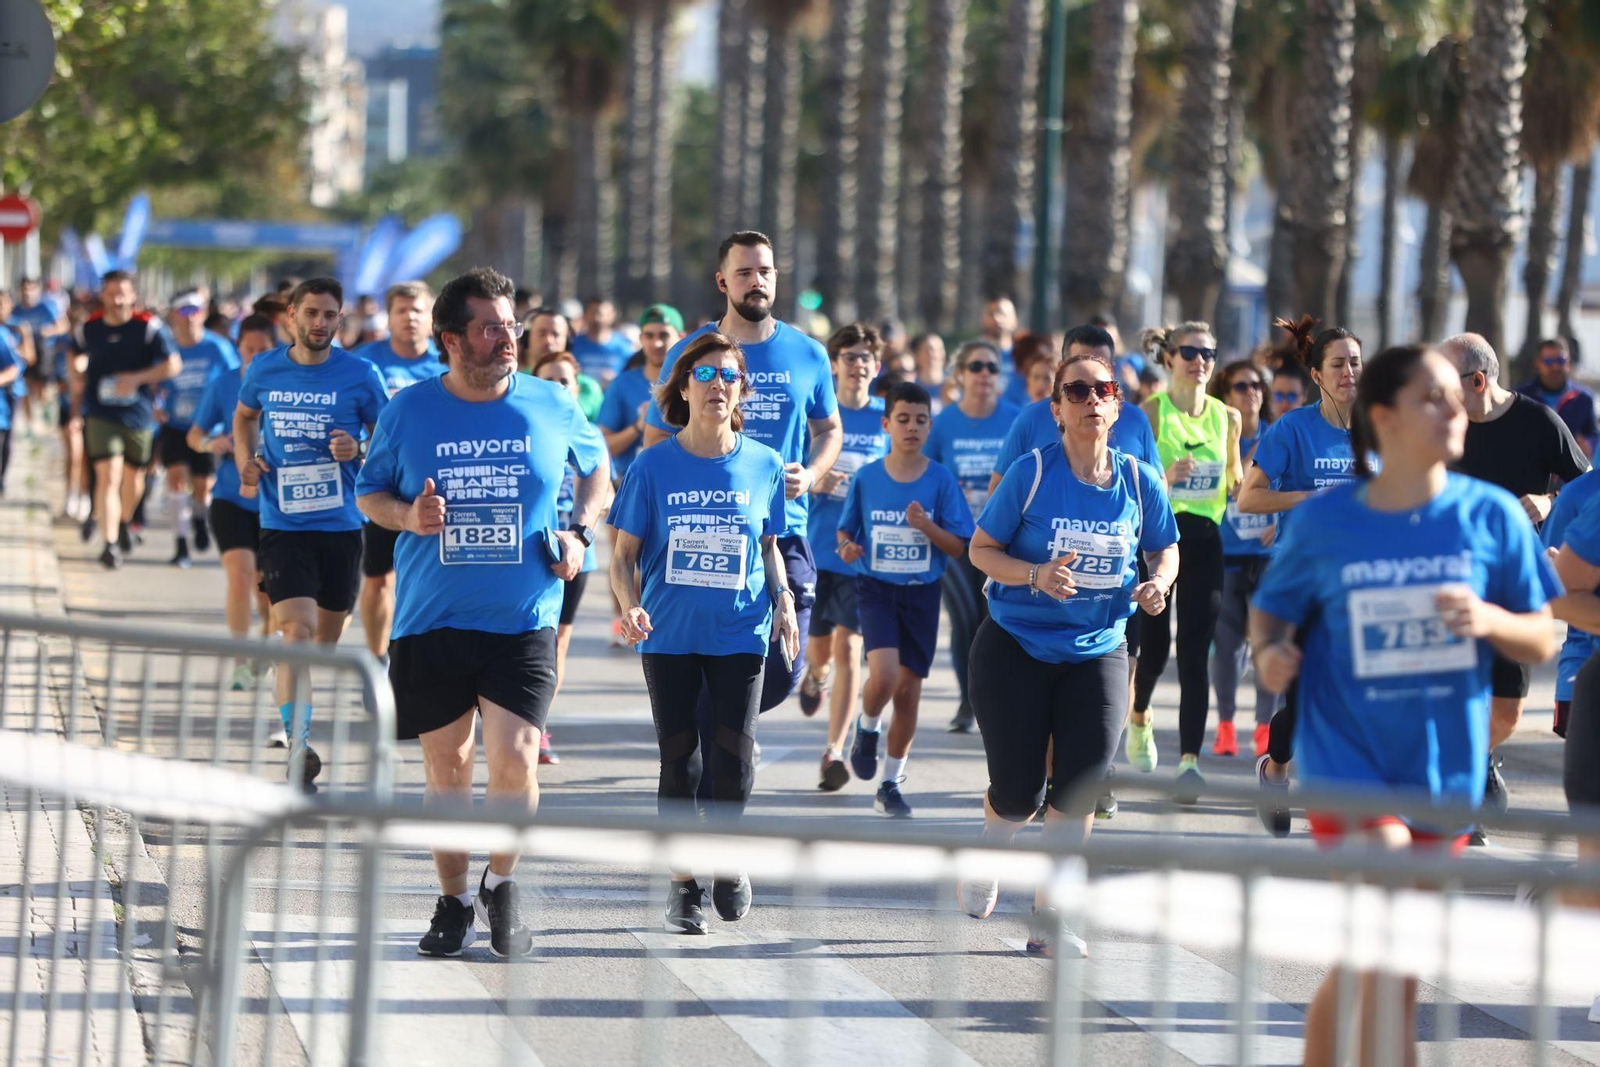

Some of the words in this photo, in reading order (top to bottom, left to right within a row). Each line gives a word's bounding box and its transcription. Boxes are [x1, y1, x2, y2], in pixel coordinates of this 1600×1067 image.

[745, 370, 791, 387] yoral
[268, 390, 337, 406] mayoral
[741, 402, 781, 411] AKES
[268, 411, 332, 423] RUNNING
[743, 411, 781, 421] ENDS
[274, 420, 326, 431] MAKES
[274, 429, 327, 440] FRIENDS
[843, 433, 886, 447] ayoral
[435, 435, 532, 458] mayoral
[437, 464, 526, 480] RUNNING
[447, 476, 519, 490] MAKES
[292, 483, 329, 499] 803
[446, 487, 520, 501] FRIENDS
[667, 490, 751, 507] mayoral
[491, 506, 517, 515] mayoral
[871, 508, 935, 525] mayal
[667, 514, 747, 526] RUNNING
[1051, 517, 1133, 537] mayoral
[449, 527, 511, 544] 1823
[675, 524, 740, 534] MAKES
[1068, 543, 1095, 552] Solidaria
[1069, 538, 1091, 546] Carrera
[884, 545, 920, 560] 330
[685, 553, 729, 571] 762
[1070, 555, 1113, 573] 725
[1341, 550, 1472, 585] mayoral
[1380, 617, 1446, 648] 783
